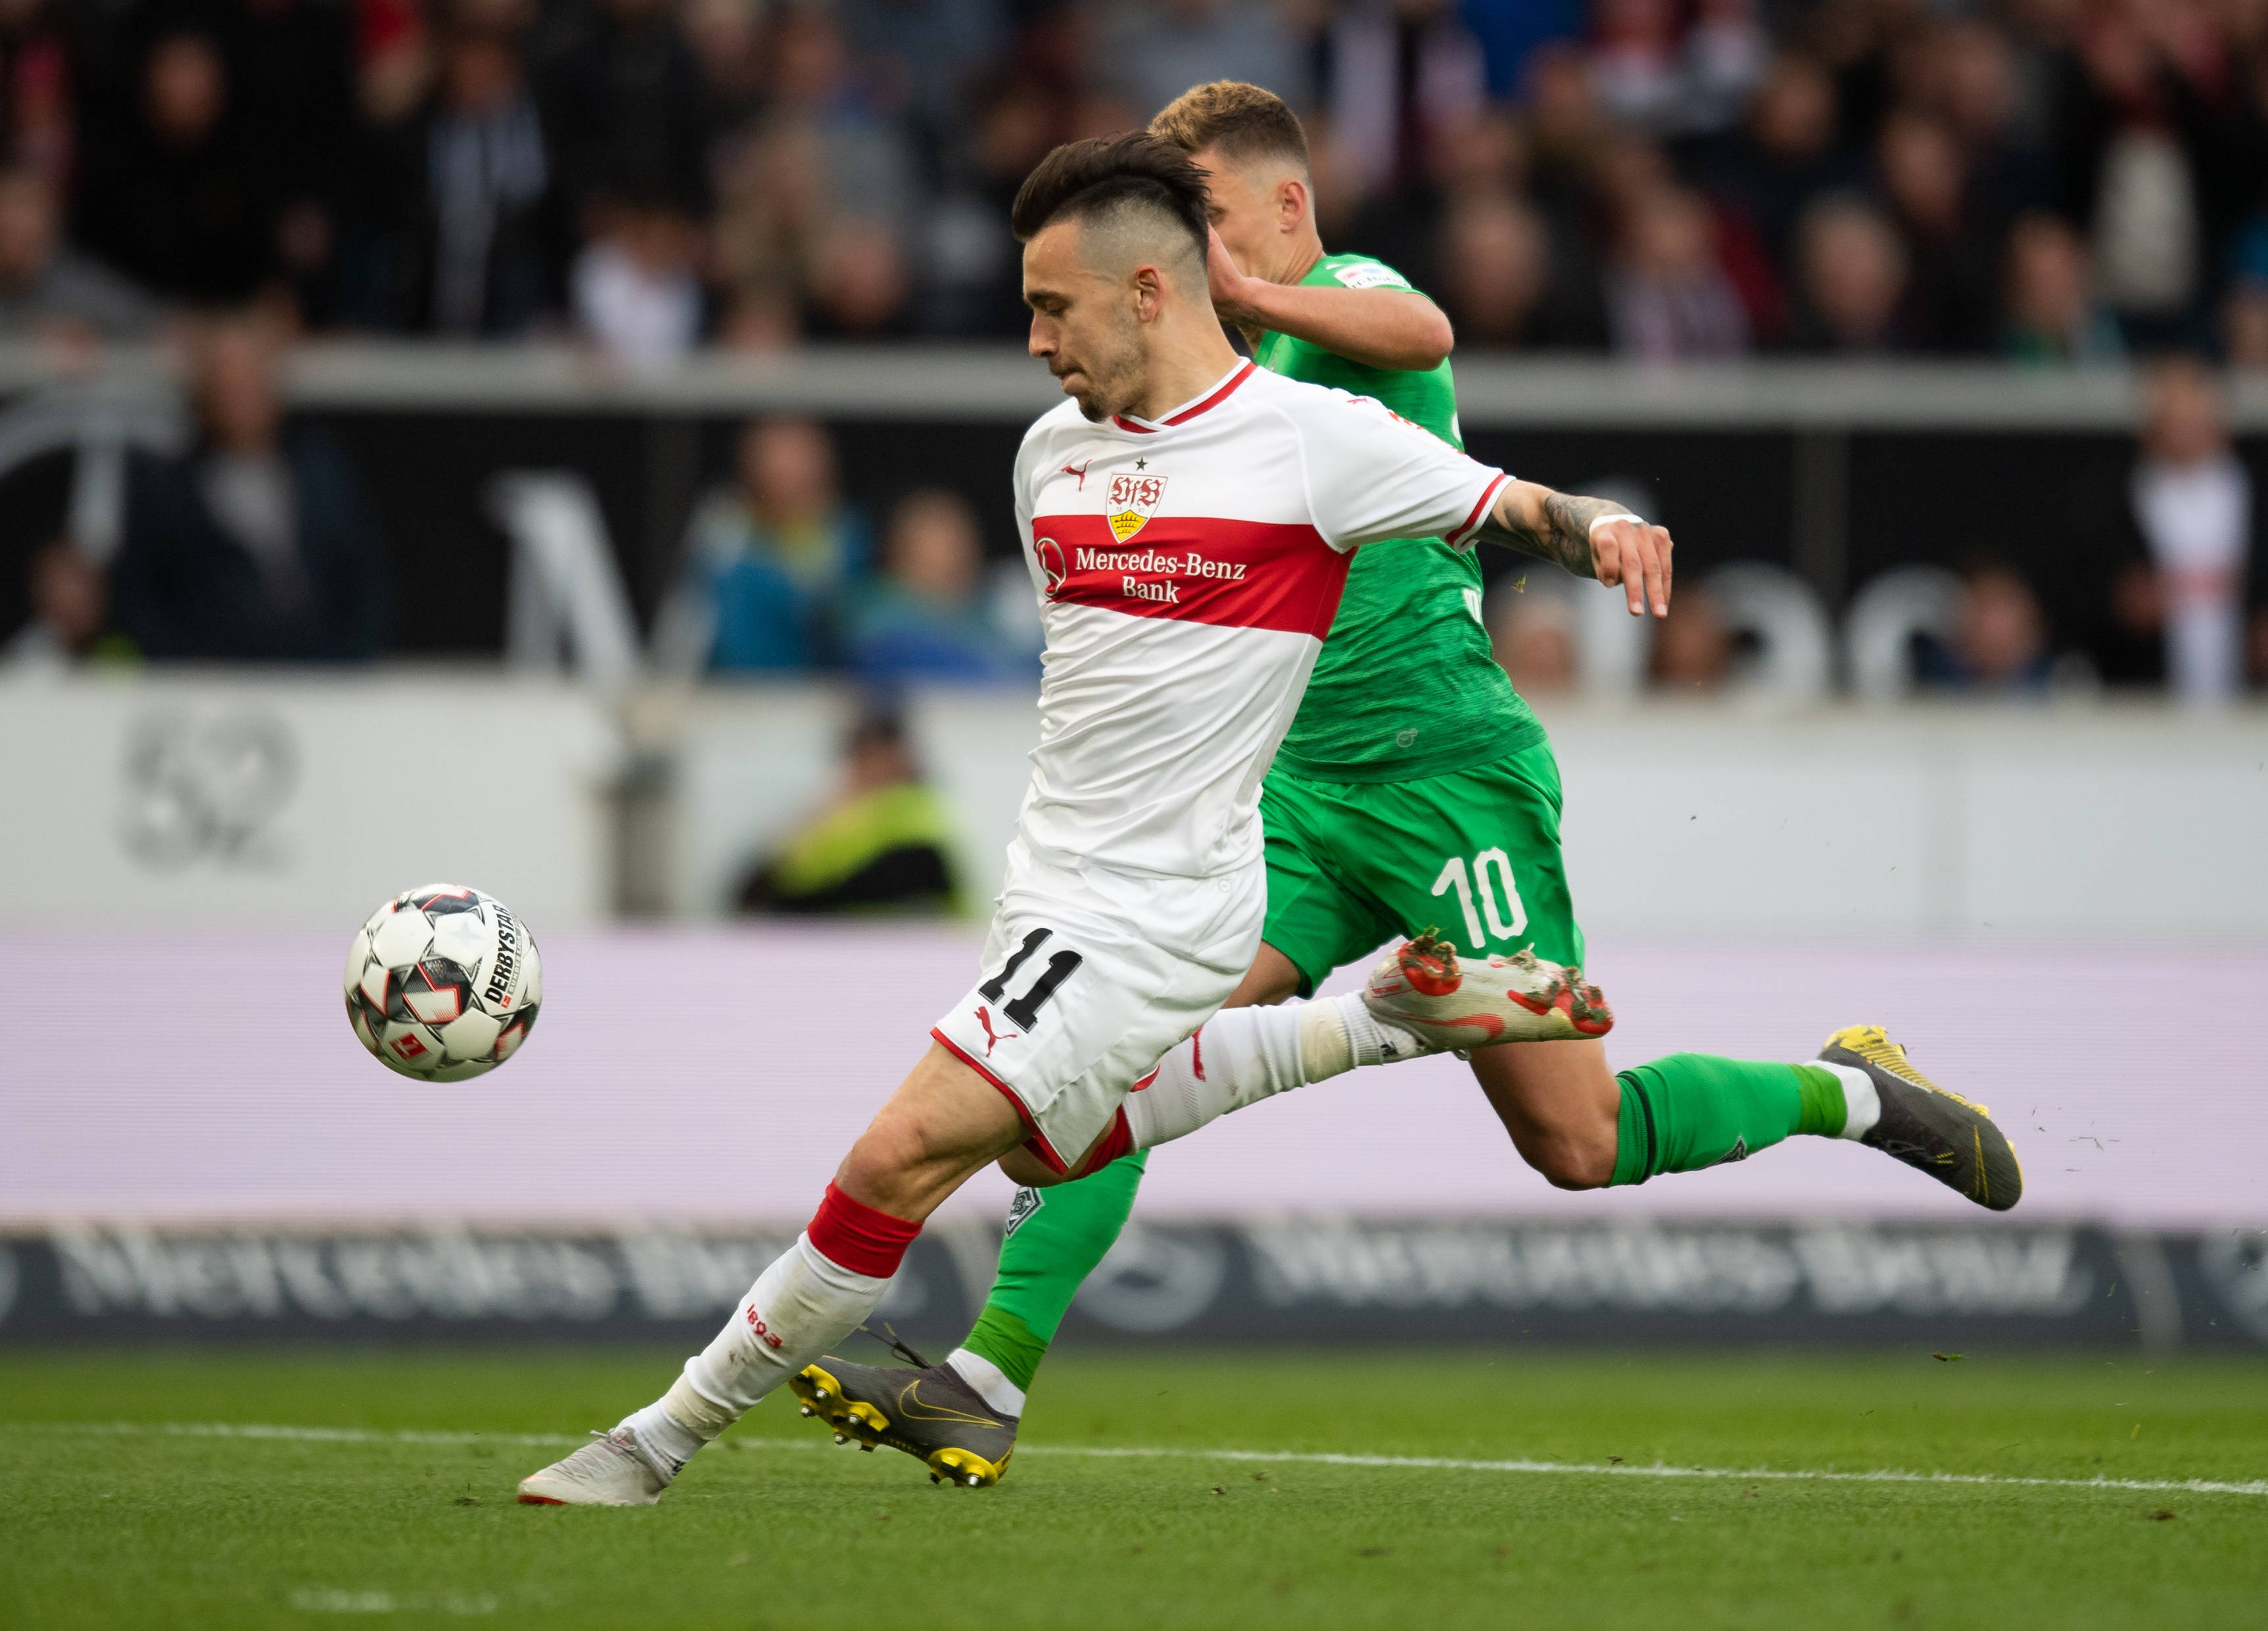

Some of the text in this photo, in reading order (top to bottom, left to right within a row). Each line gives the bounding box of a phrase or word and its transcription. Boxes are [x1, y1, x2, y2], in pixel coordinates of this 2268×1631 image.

[1075, 547, 1247, 580] Mercedes-Benz
[1122, 576, 1181, 603] Bank
[1431, 846, 1528, 949] 10
[484, 905, 515, 1005] DERBYSTAR
[978, 928, 1083, 1034] 11
[747, 1304, 782, 1348] 1893
